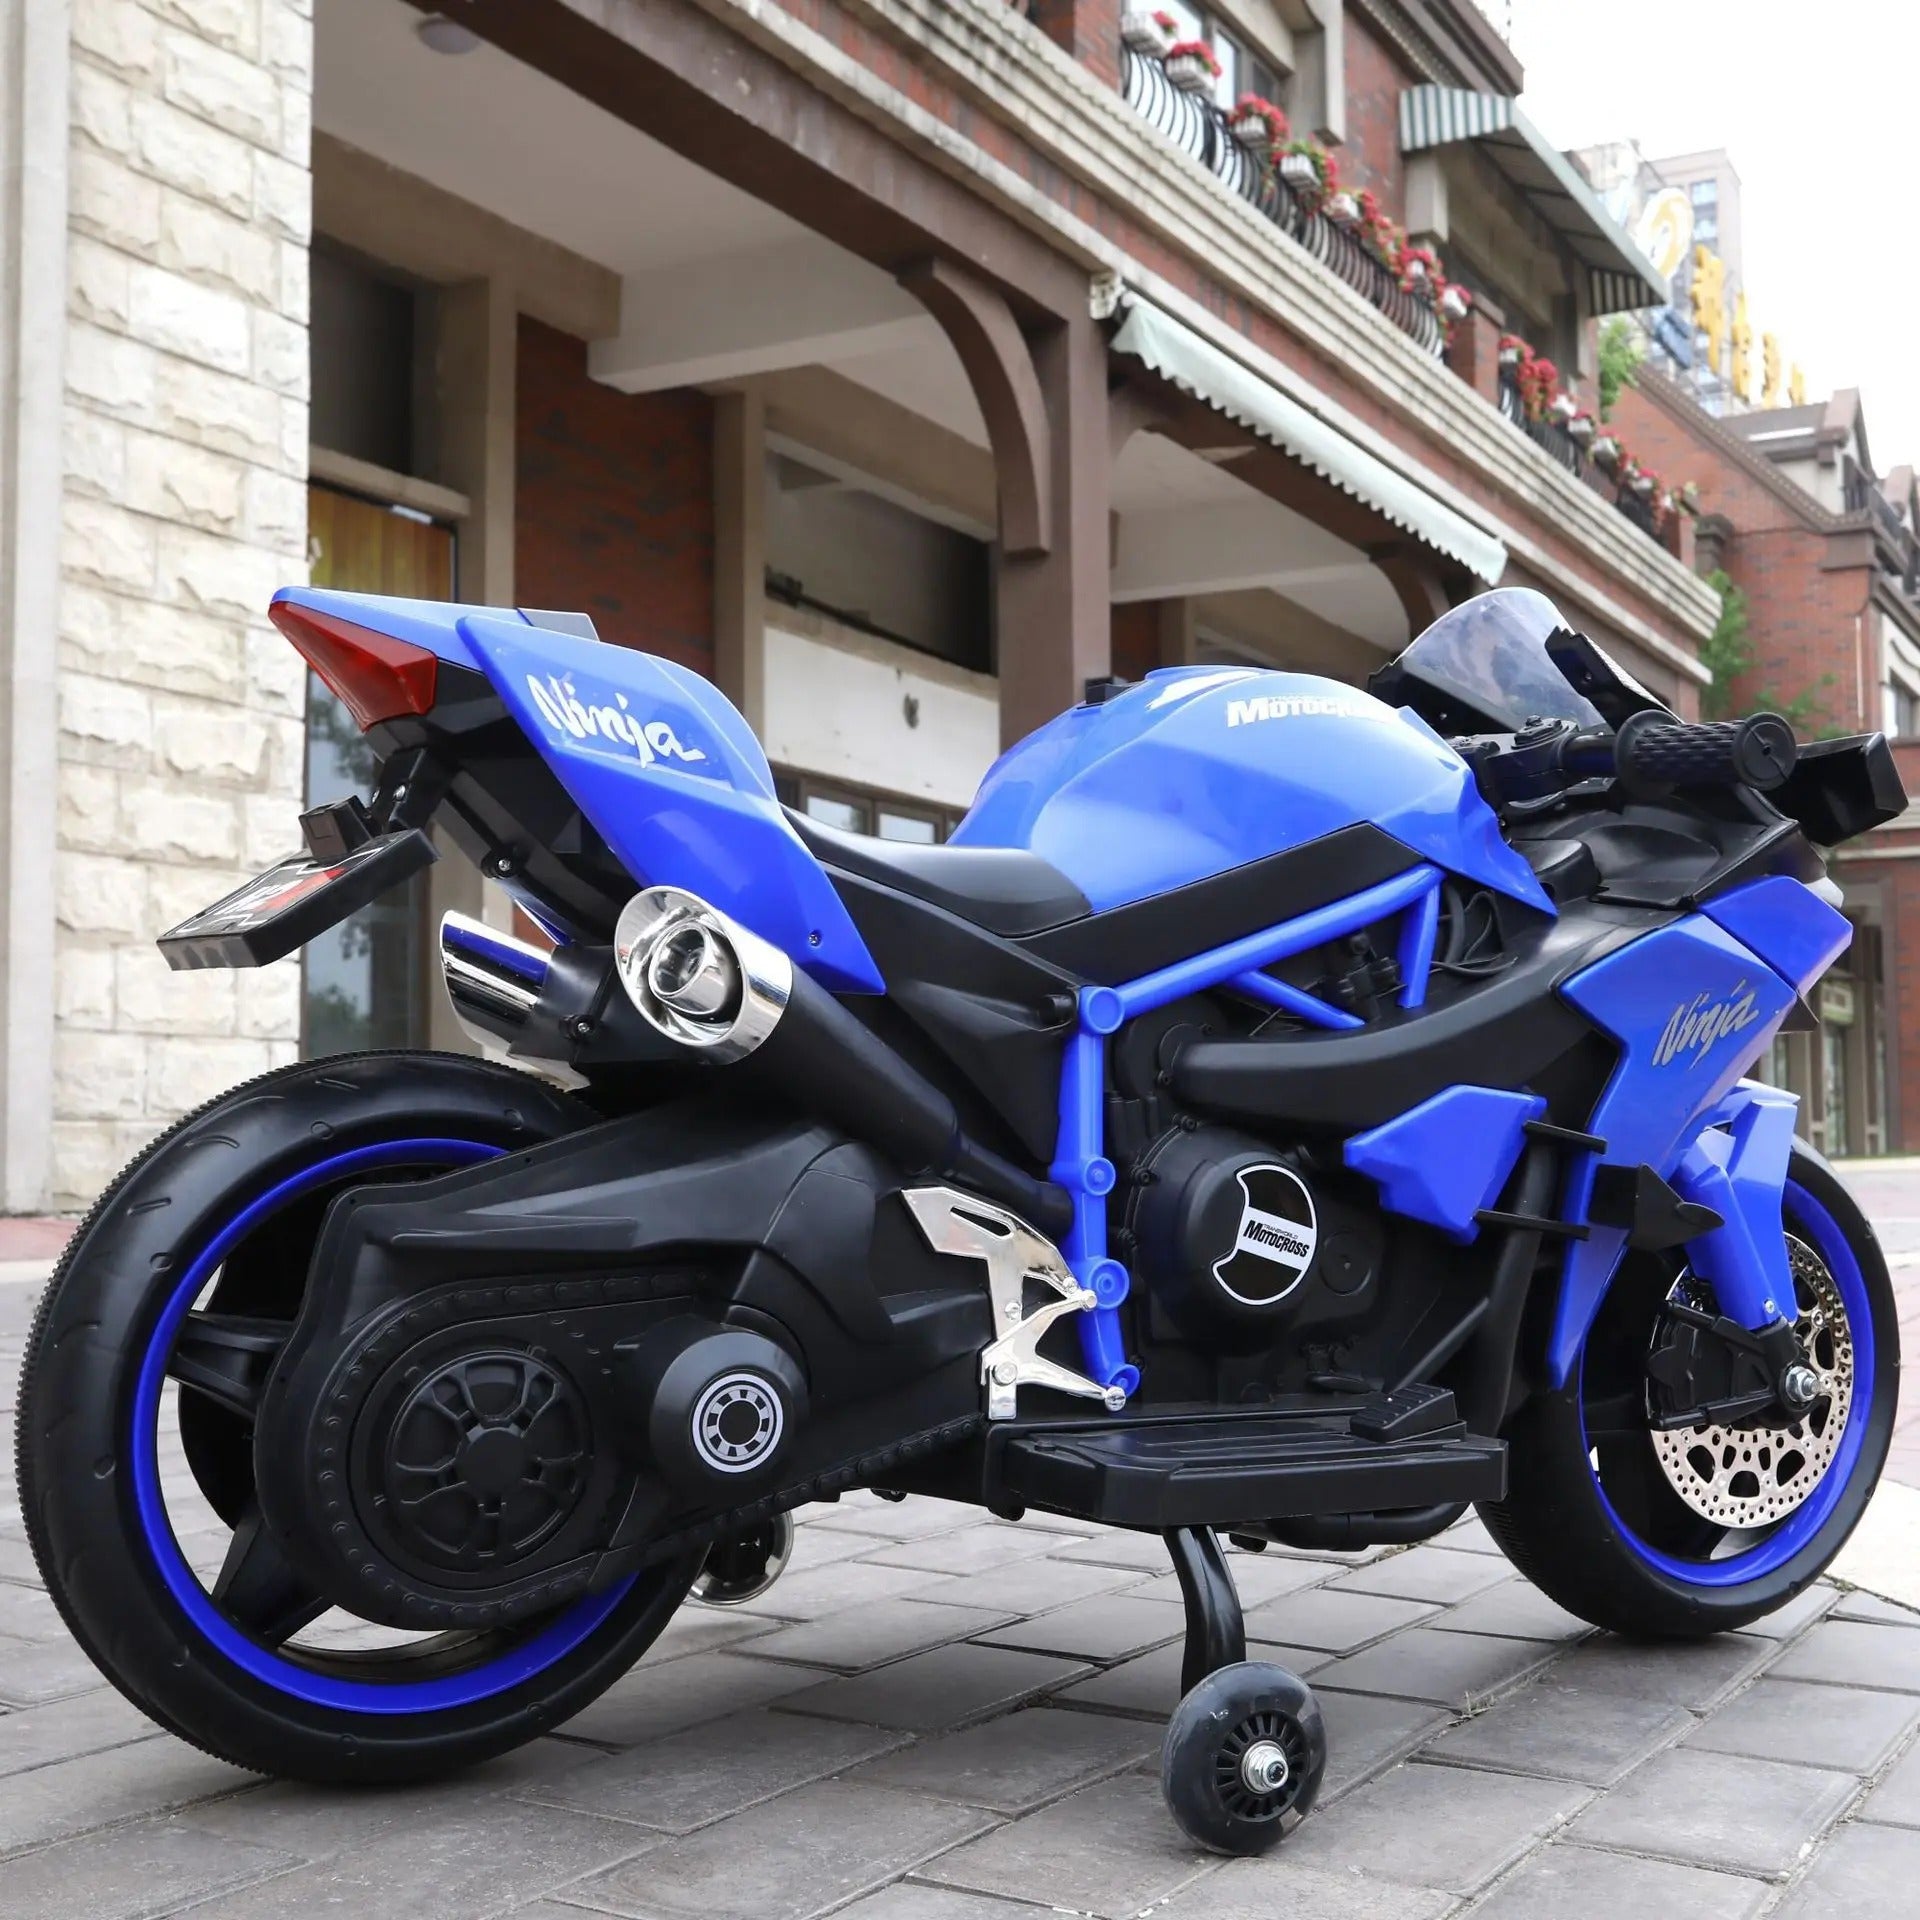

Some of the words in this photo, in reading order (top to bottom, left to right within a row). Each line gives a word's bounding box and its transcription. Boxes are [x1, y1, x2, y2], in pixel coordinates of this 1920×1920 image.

[526, 672, 706, 769] Ninja
[1227, 697, 1385, 728] MOTOCR
[1652, 979, 1759, 1071] Ninja
[1243, 1219, 1310, 1258] MOTOCROSS
